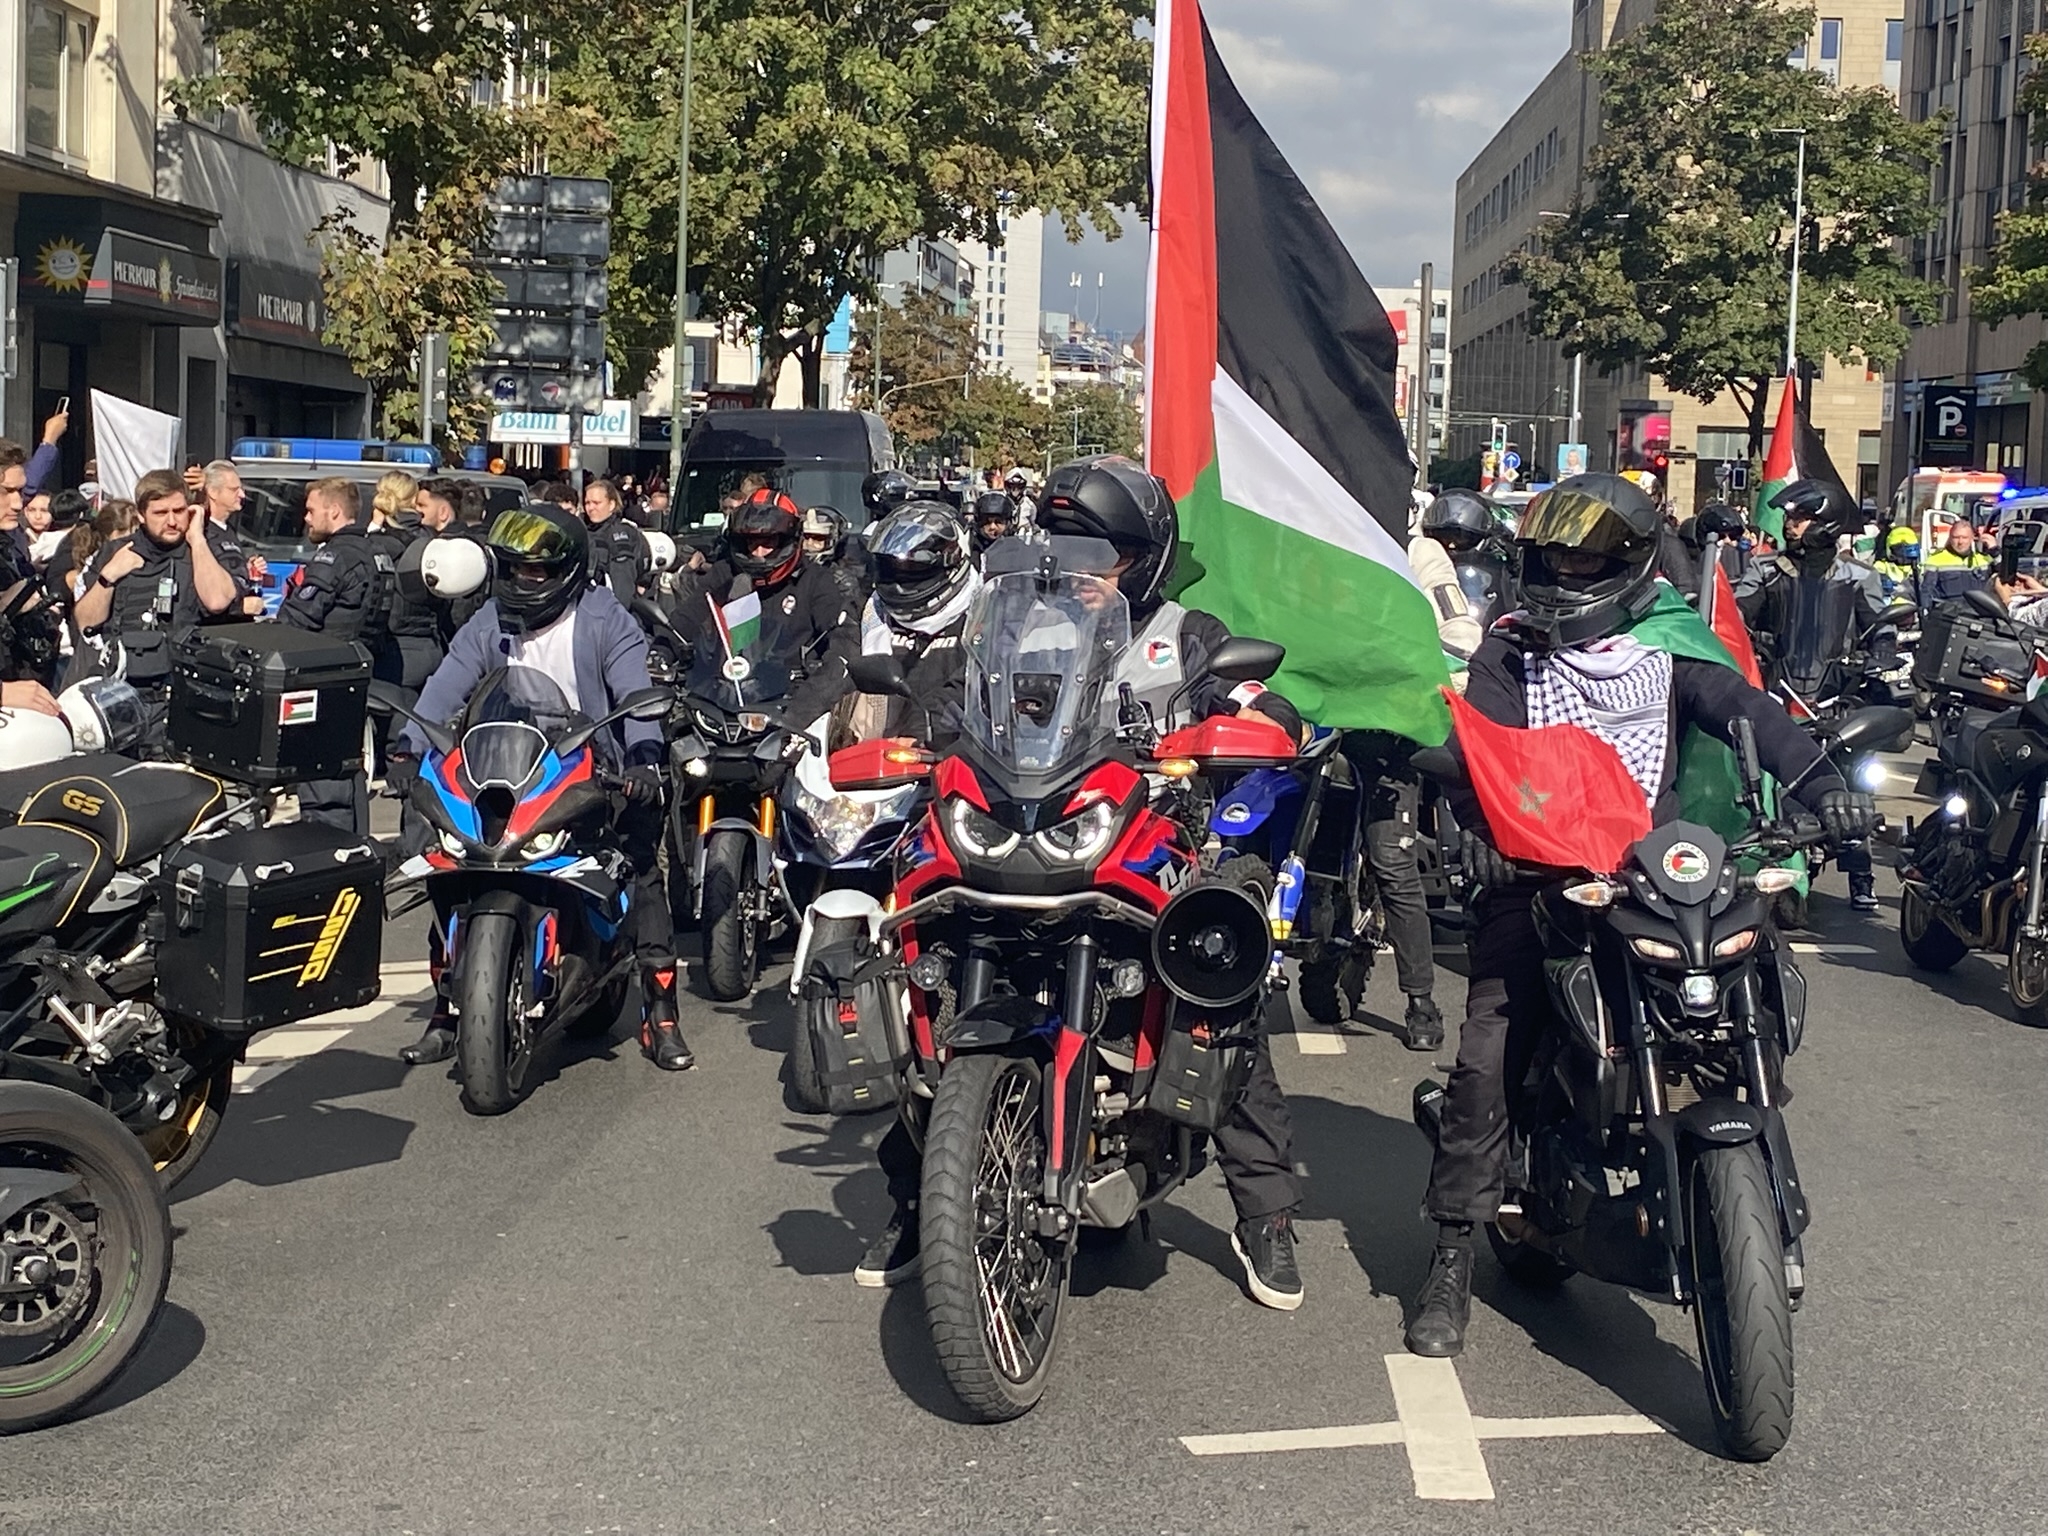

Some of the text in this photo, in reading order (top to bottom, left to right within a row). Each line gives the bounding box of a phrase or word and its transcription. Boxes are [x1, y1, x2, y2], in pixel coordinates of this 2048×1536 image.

[114, 260, 158, 289] MERKUR
[258, 293, 304, 327] MERKUR
[570, 409, 627, 432] otel
[1938, 405, 1963, 437] P
[62, 788, 106, 817] GS
[1708, 1120, 1753, 1133] YAMAHA
